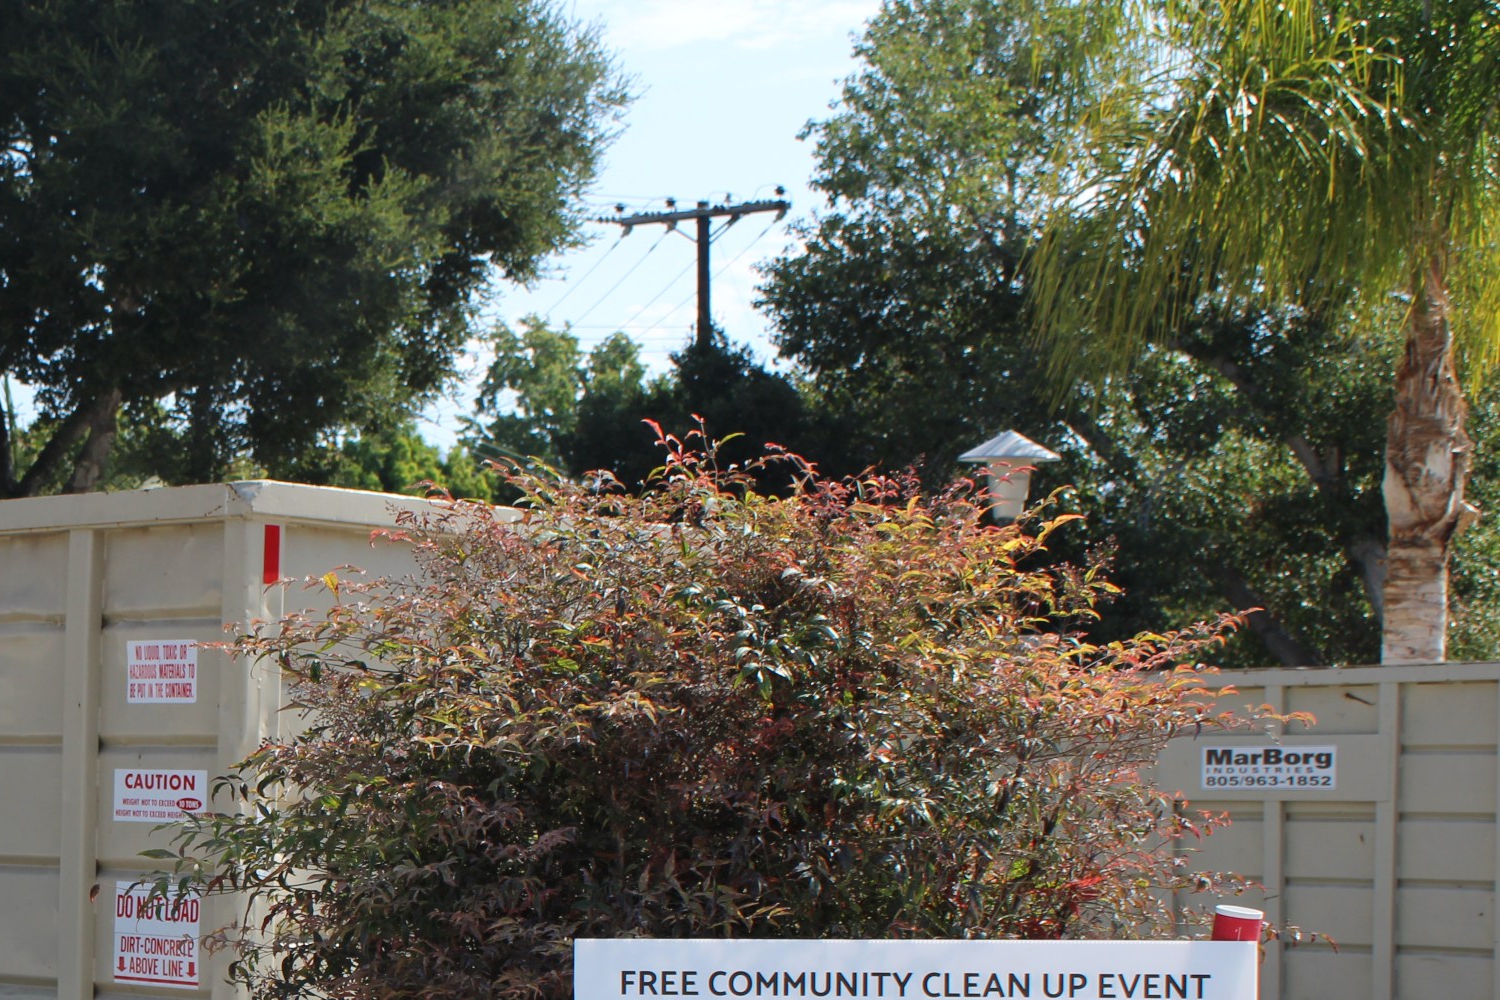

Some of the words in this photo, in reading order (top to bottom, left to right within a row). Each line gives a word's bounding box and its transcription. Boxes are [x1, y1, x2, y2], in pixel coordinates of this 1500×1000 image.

[1206, 749, 1333, 769] MarBorg
[125, 773, 196, 791] CAUTION
[1206, 776, 1332, 786] 805/963-1852
[117, 894, 134, 919] DO
[165, 898, 199, 923] LOAD
[120, 935, 194, 958] DIRT-CONCRETE
[129, 956, 159, 975] ABOVE
[162, 959, 184, 978] LINE
[621, 970, 699, 996] FREE
[708, 970, 913, 997] COMMUNITY
[921, 972, 1030, 998] CLEAN
[1042, 973, 1088, 998] UP
[1098, 973, 1211, 999] EVENT
